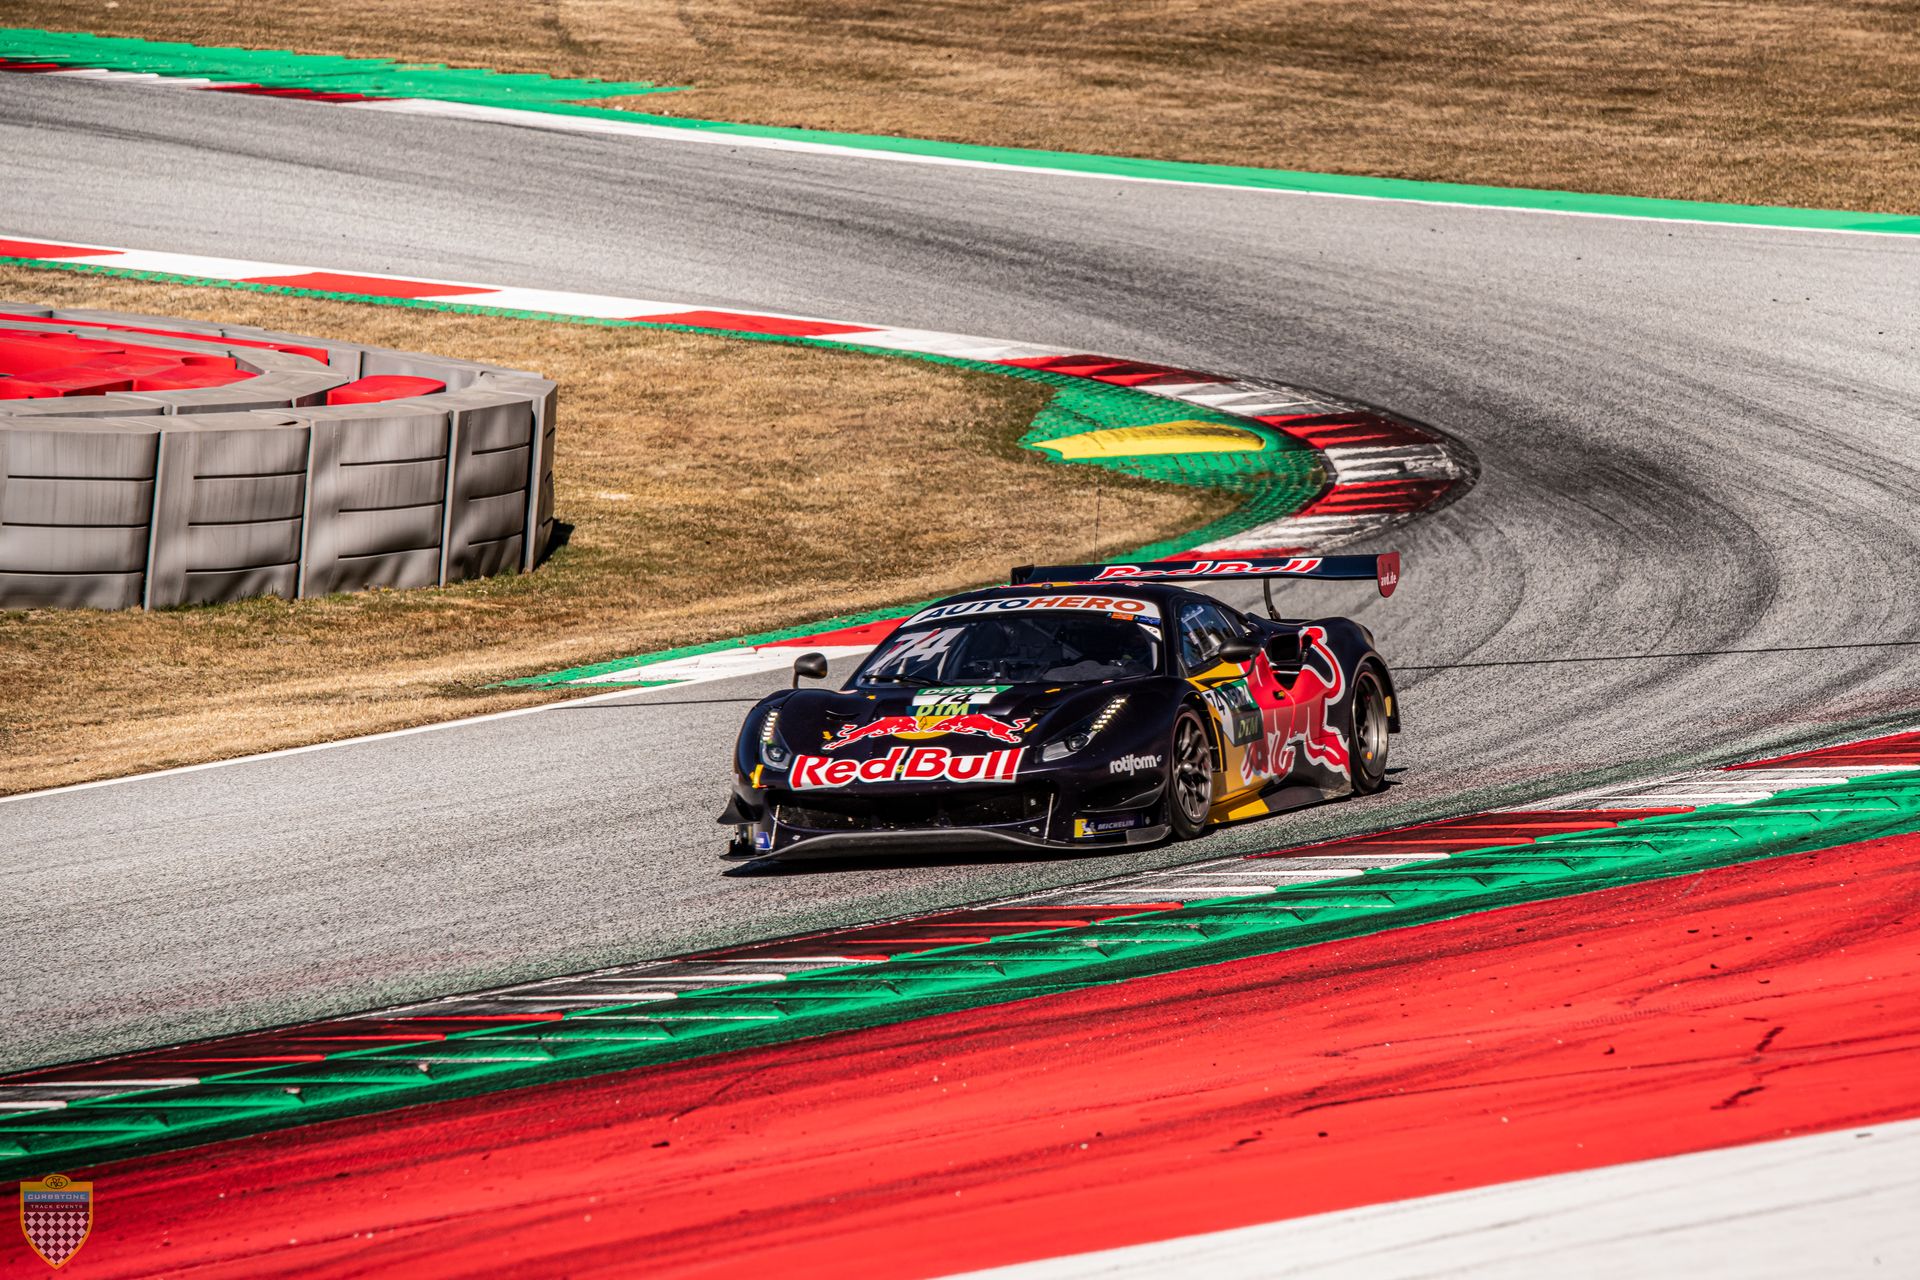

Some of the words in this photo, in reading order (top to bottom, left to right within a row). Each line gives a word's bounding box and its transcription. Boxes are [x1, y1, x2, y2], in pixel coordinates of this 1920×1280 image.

[1093, 560, 1213, 581] Red
[1203, 557, 1323, 575] Bull
[922, 598, 1145, 618] AUTOHERO
[864, 627, 966, 673] 74
[922, 686, 998, 695] DEKRA
[916, 703, 969, 717] DTM
[1205, 692, 1225, 716] 74
[788, 746, 908, 791] Red
[902, 746, 1025, 784] Bull
[1097, 820, 1135, 830] MICHELIN
